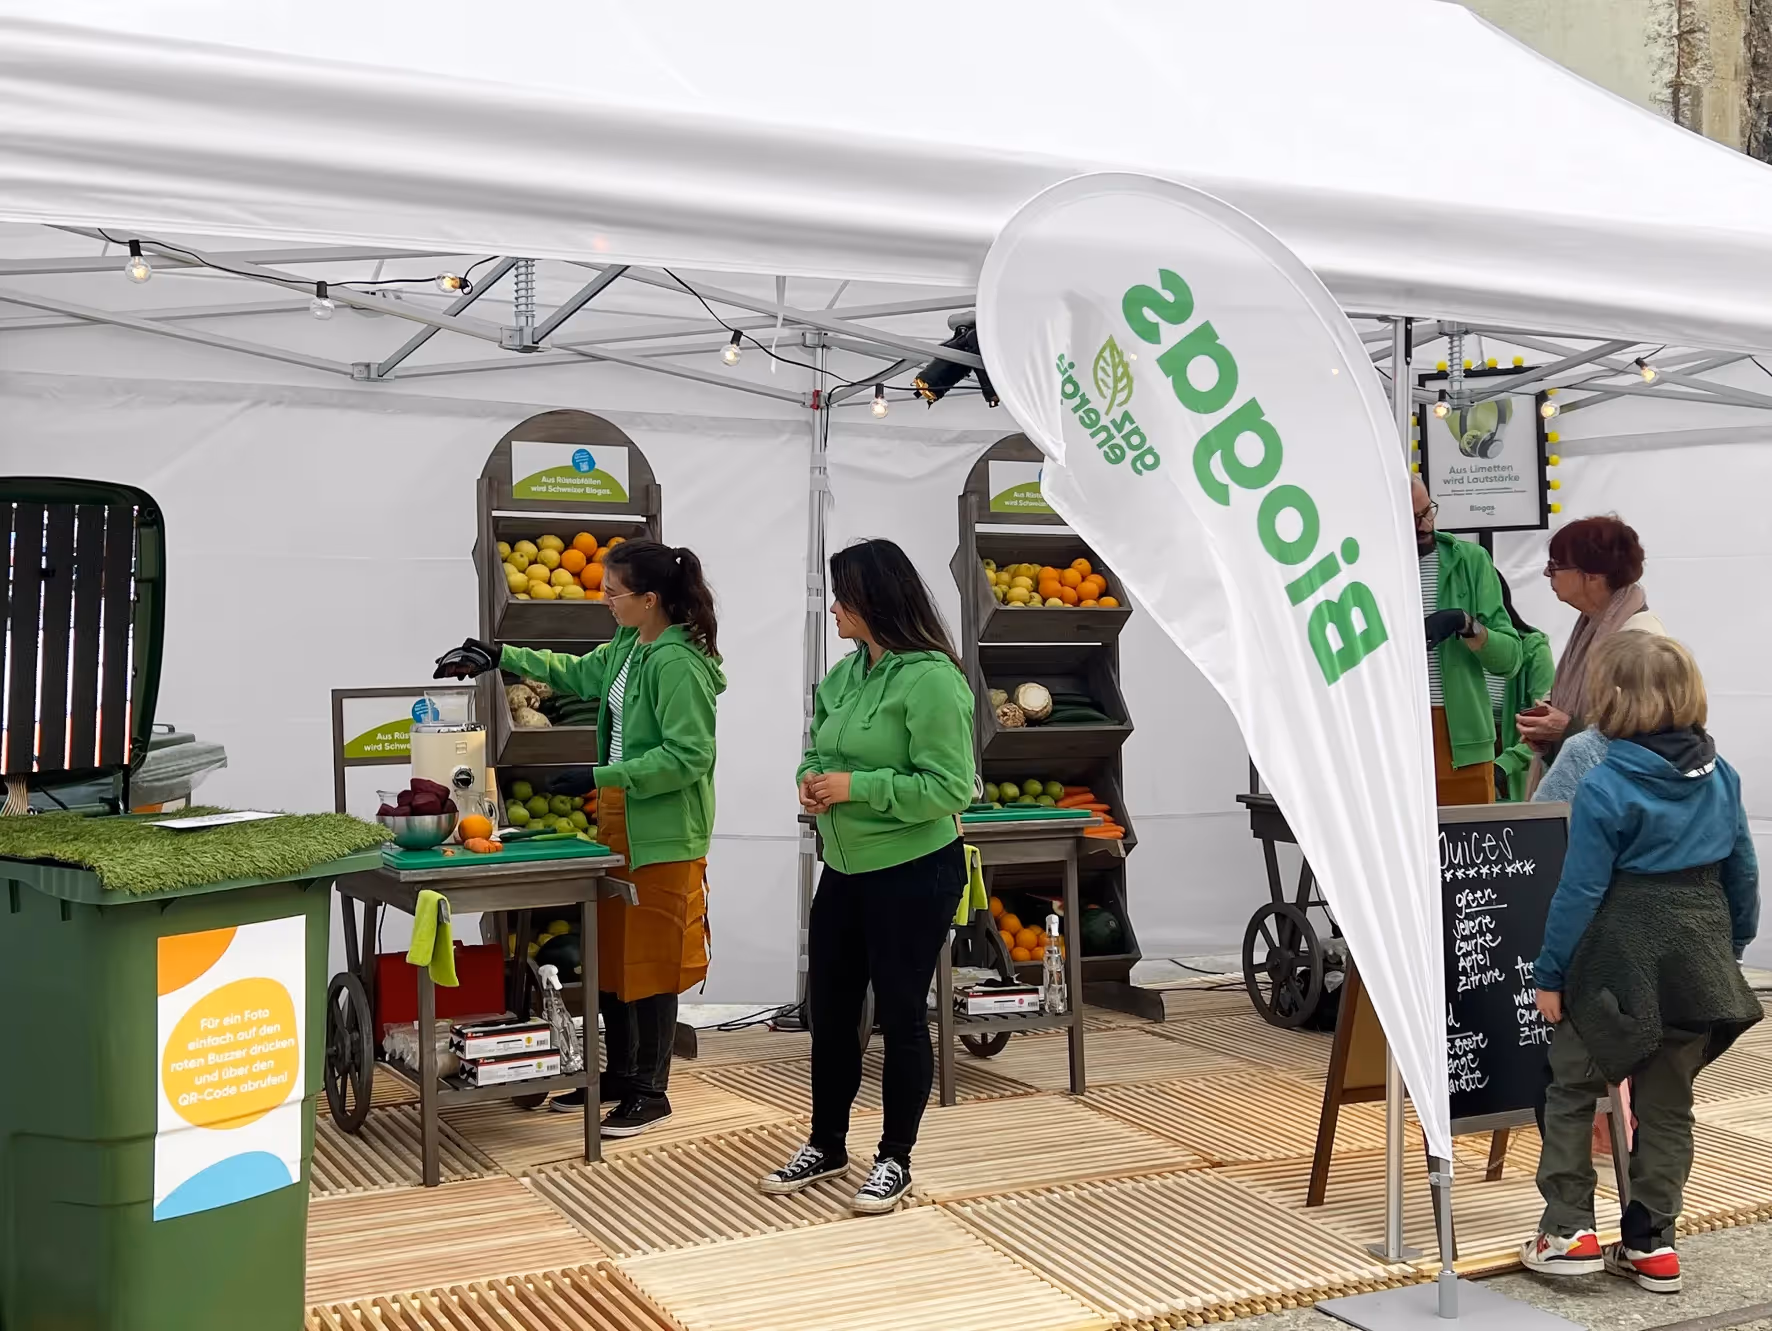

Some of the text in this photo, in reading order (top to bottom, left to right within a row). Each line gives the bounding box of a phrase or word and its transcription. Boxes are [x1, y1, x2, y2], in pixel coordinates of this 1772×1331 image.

[541, 475, 601, 485] Aus Rüstabfällen
[1443, 474, 1520, 485] wird Lautstärke
[1449, 464, 1513, 474] Aus Limetten
[548, 485, 584, 494] Schweizer
[586, 487, 612, 495] Biogas.
[364, 743, 382, 751] wird
[376, 732, 392, 740] Aus
[1455, 888, 1497, 919] green
[1455, 933, 1501, 955] Gurke
[1457, 968, 1505, 992] Zitrone
[200, 1008, 270, 1031] Für ein Foto
[187, 1023, 281, 1050] einfach auf den
[170, 1037, 295, 1072] roten Buzzer drücken
[194, 1059, 275, 1085] und über den
[178, 1071, 288, 1106] QR-Code abrufen!
